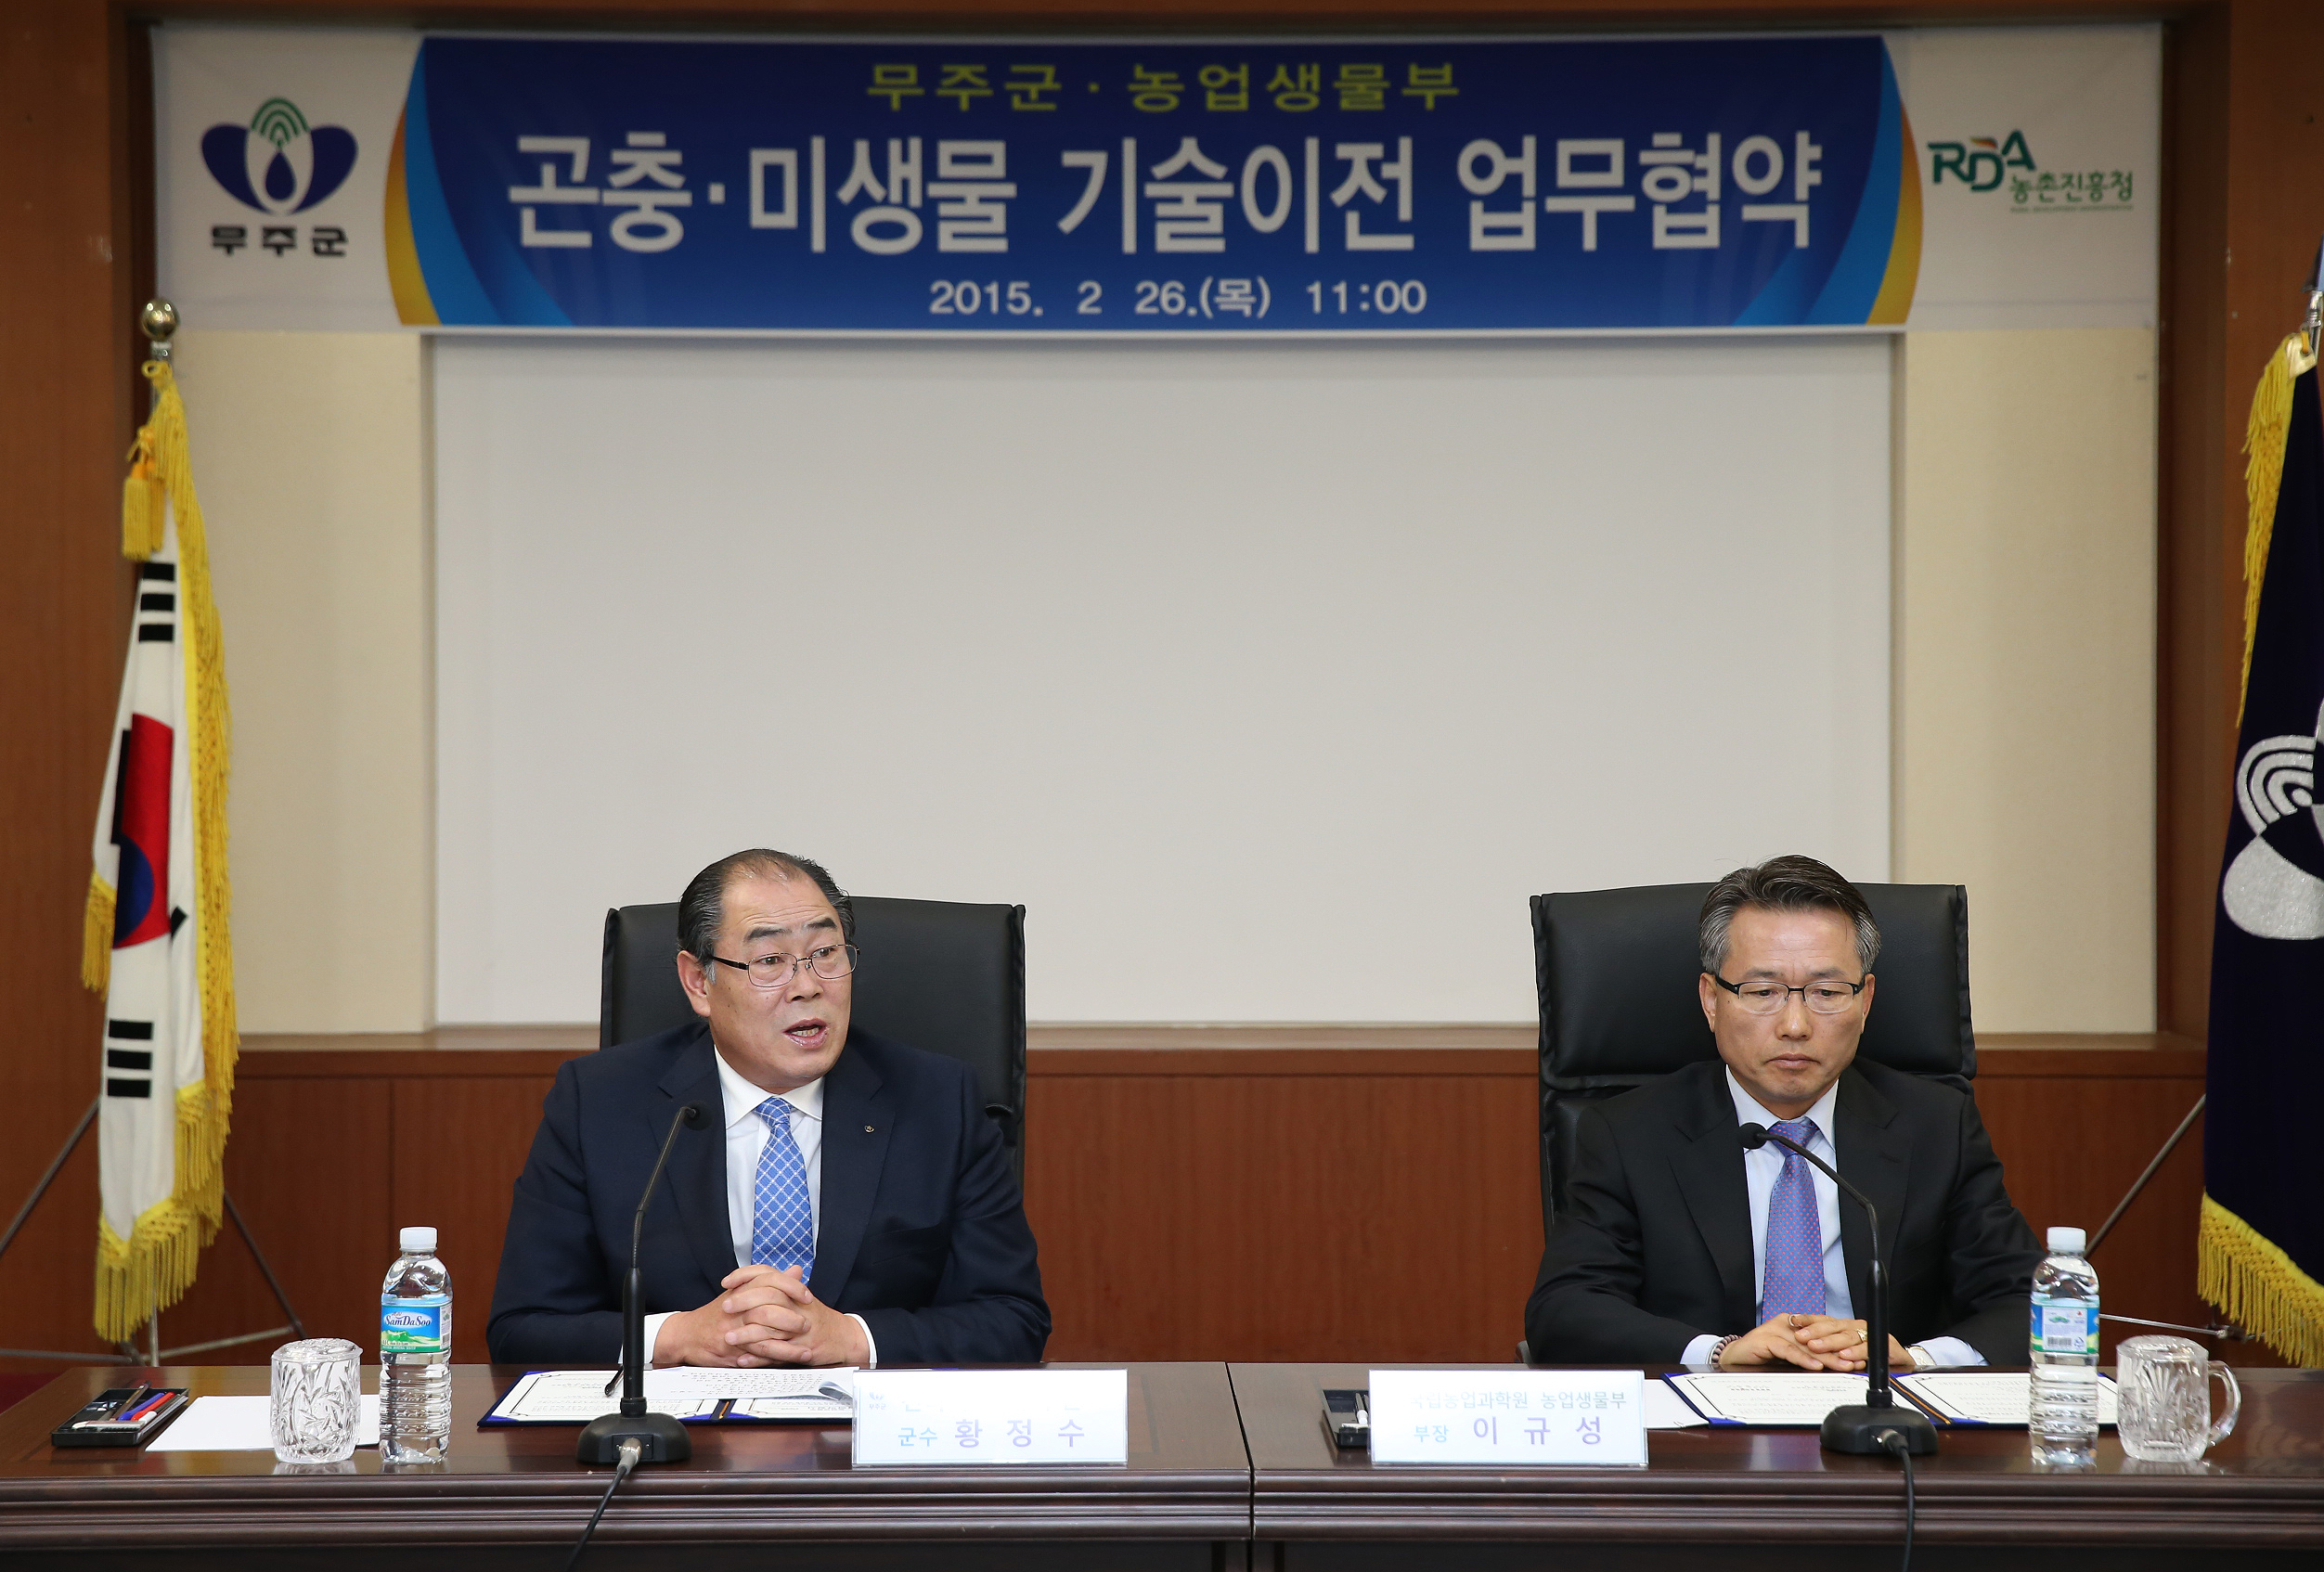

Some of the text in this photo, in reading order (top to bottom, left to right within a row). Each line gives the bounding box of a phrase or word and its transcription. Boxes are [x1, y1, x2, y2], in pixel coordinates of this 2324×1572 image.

[867, 64, 1061, 112] 무주군
[1128, 62, 1459, 112] 농업생물부
[1927, 129, 2036, 192] RDA
[509, 131, 1822, 254] 곤충·미생물 기술이전 업무협약
[2009, 169, 2134, 204] 농촌진흥청
[211, 225, 348, 257] 무주군
[929, 277, 1428, 319] 2015. 2 26.(목) 11:00
[384, 1315, 431, 1327] SamDaSoo
[1540, 1391, 1627, 1410] 농업생물부
[897, 1426, 938, 1447] 군수
[1414, 1424, 1450, 1444] 부장
